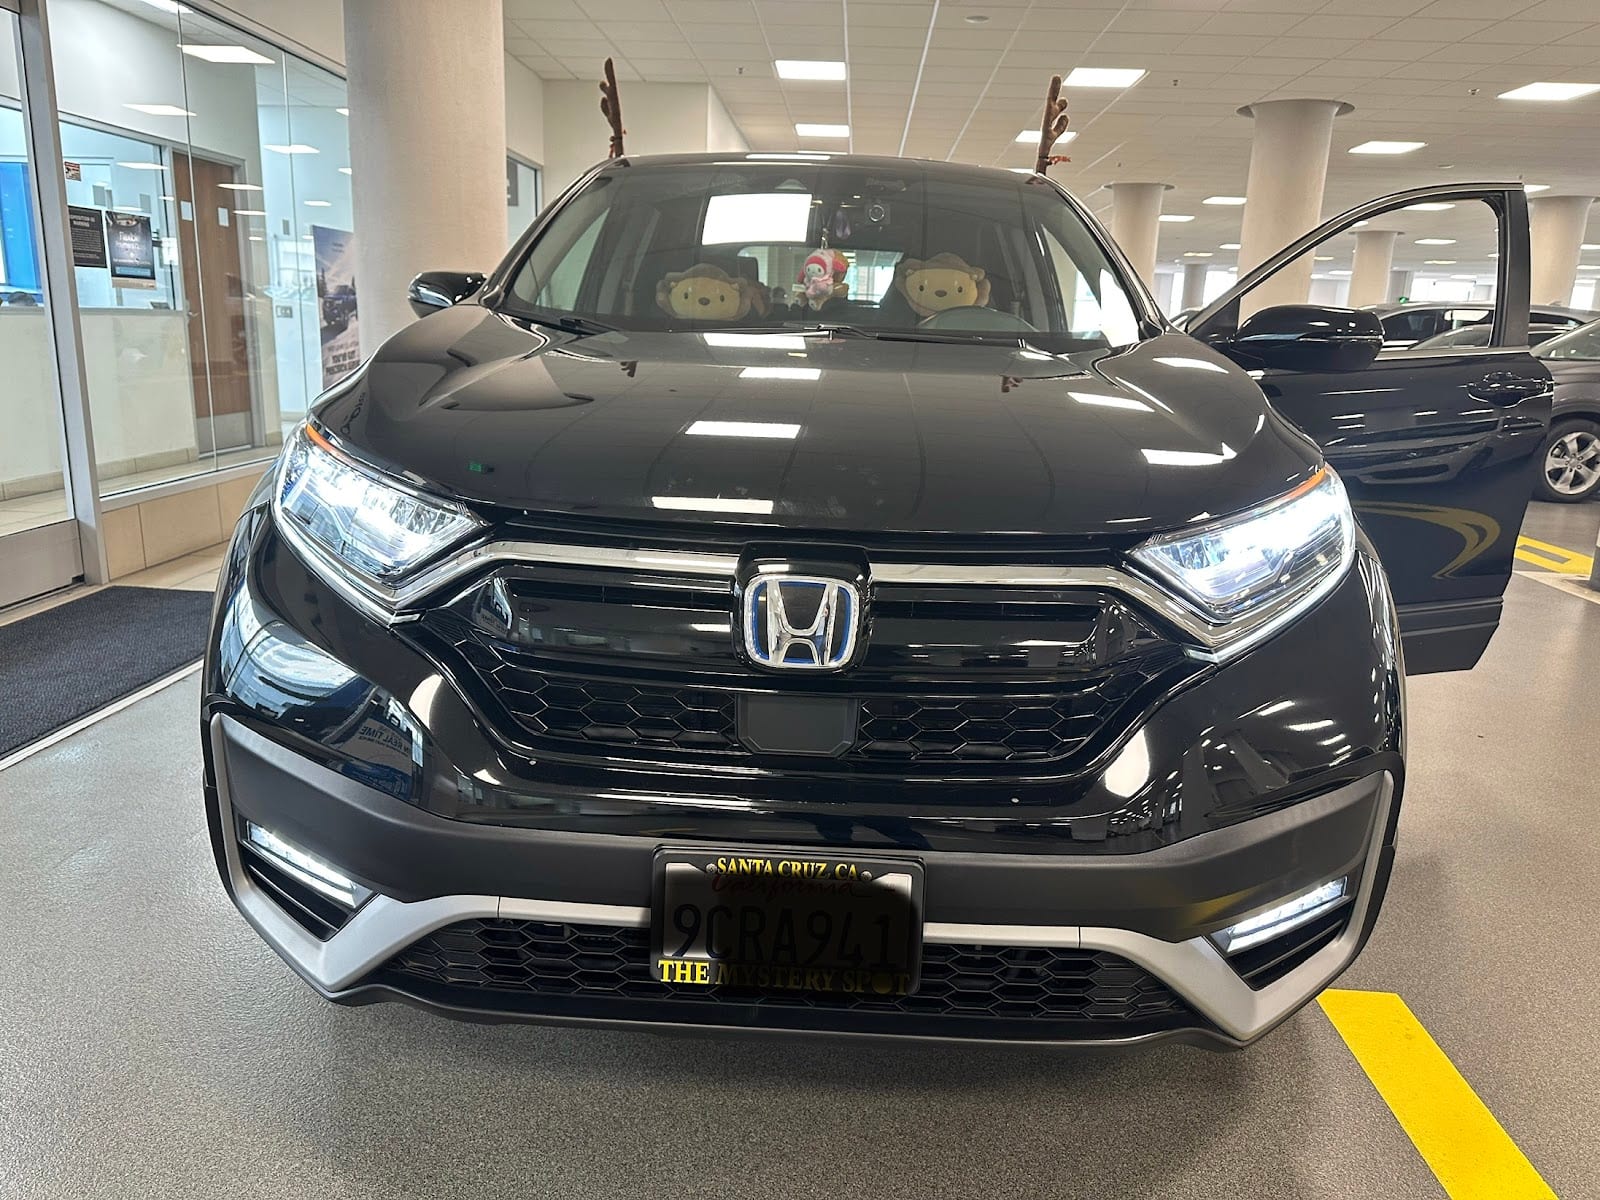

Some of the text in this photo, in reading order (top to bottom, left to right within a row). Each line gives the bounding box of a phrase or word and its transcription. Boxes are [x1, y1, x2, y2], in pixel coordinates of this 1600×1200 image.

[716, 857, 774, 877] SANTA
[835, 863, 859, 880] CA
[671, 903, 896, 969] 9CRA941
[658, 959, 710, 984] THE
[715, 962, 835, 991] MYSTERY
